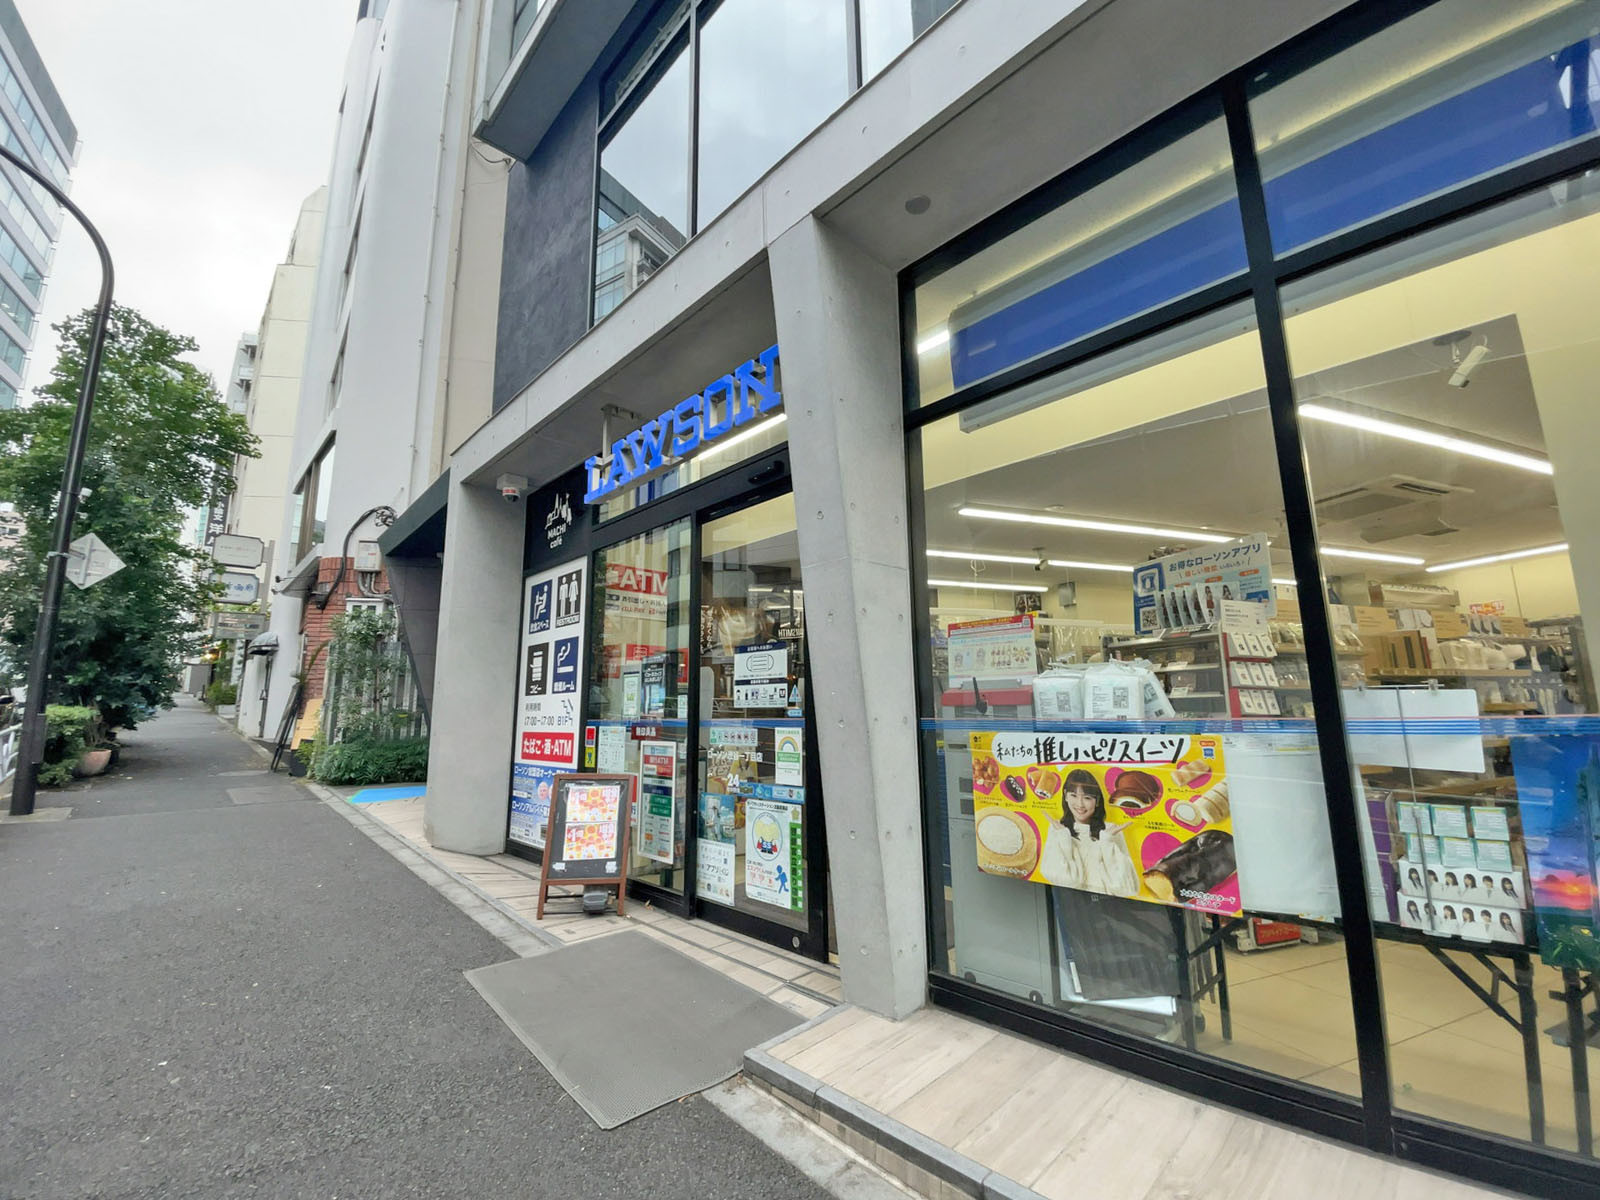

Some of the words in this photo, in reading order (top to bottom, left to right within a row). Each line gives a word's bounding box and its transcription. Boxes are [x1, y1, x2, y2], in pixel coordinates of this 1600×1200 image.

[584, 344, 781, 504] LAWSON
[547, 523, 567, 539] MACHI
[1169, 543, 1261, 572] お得なローソンアプリ
[619, 569, 668, 593] ATM
[997, 742, 1033, 761] 私たちの
